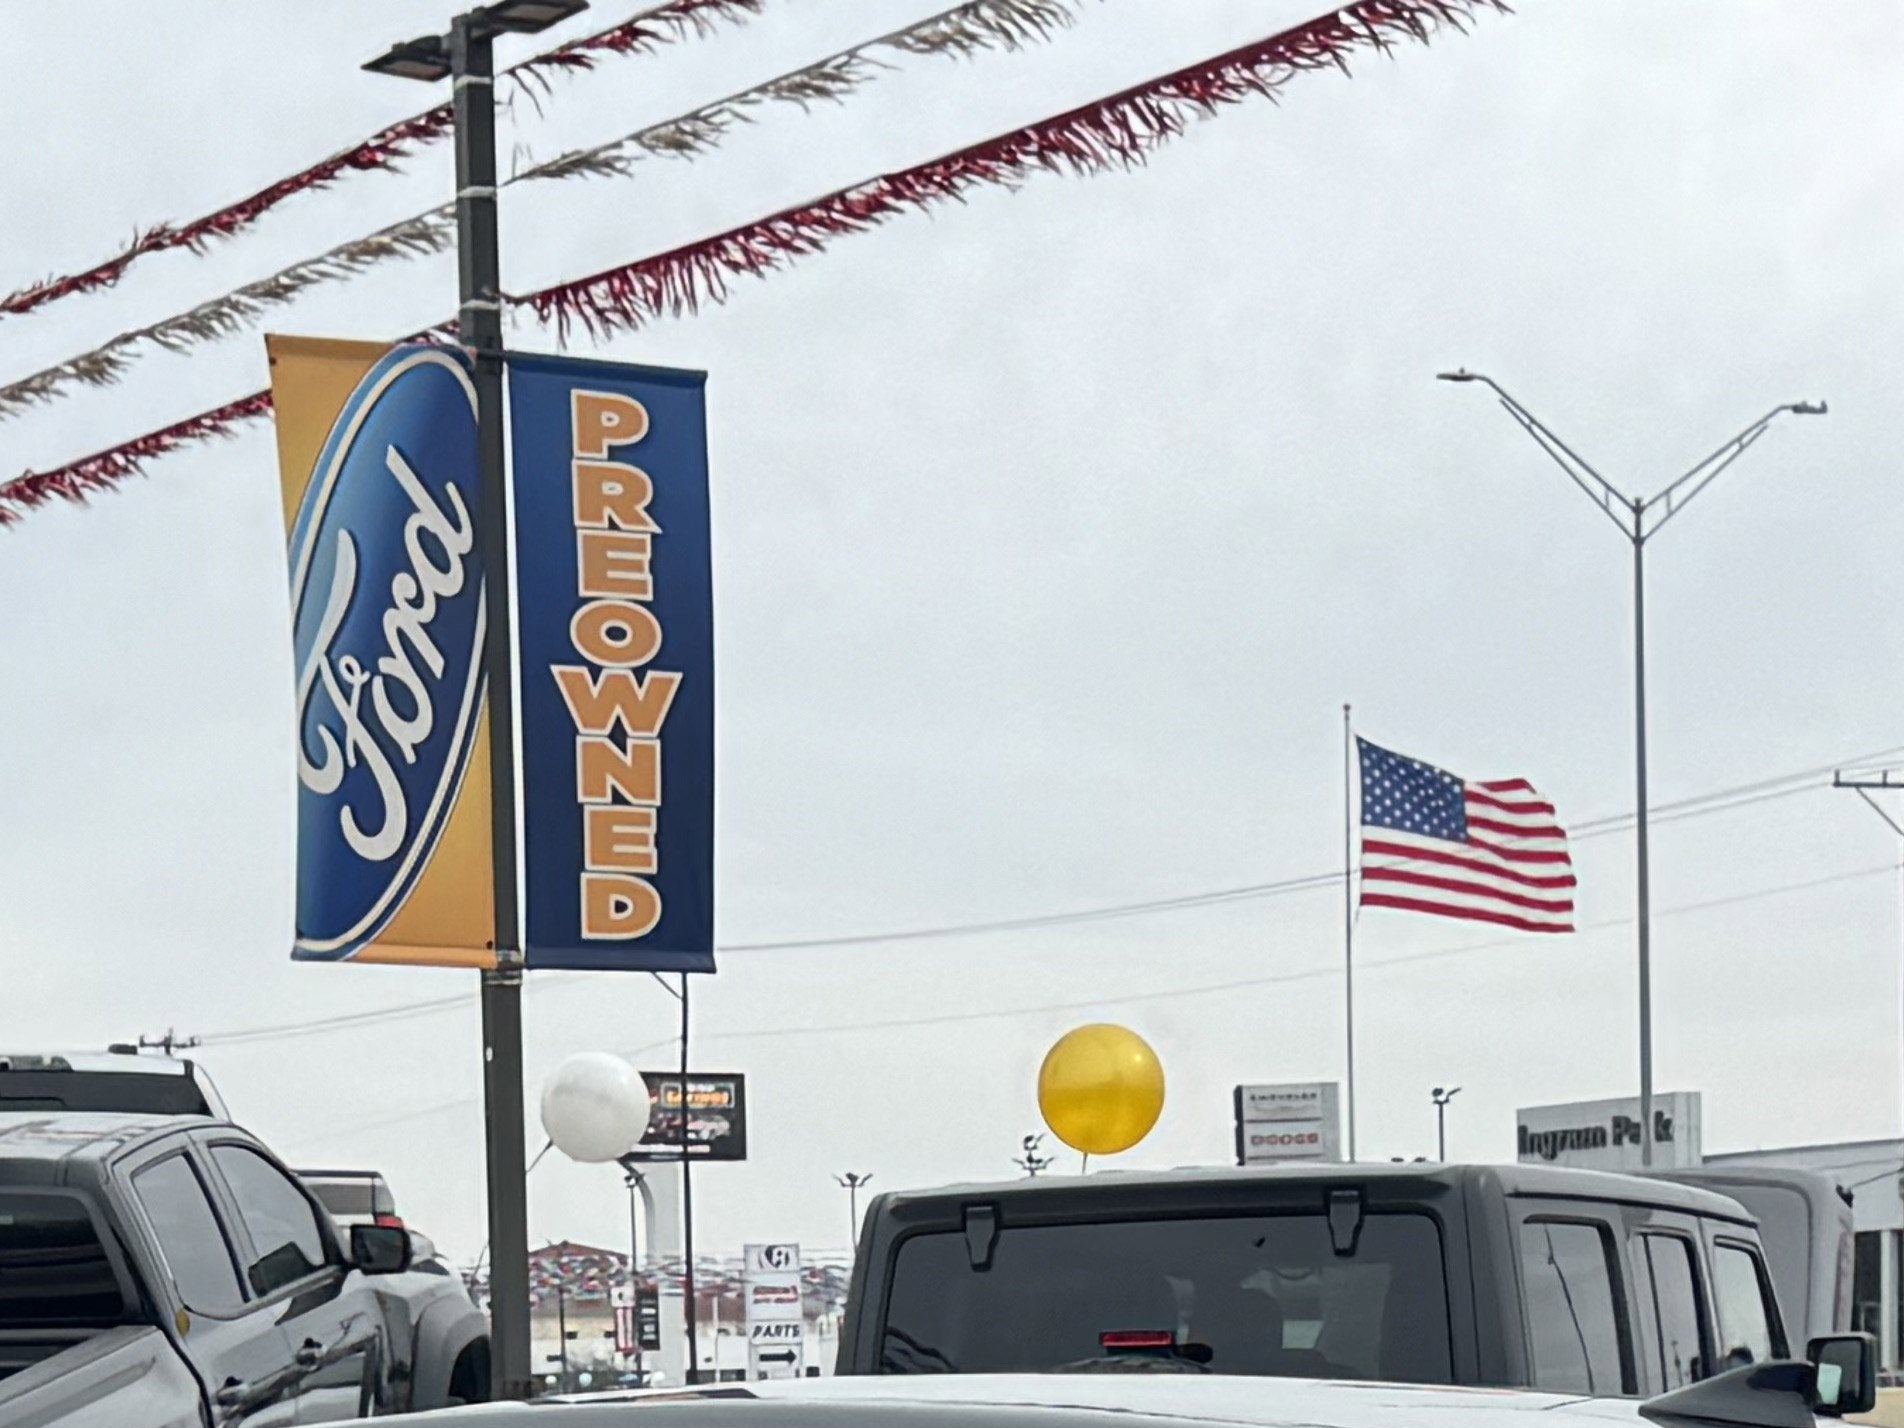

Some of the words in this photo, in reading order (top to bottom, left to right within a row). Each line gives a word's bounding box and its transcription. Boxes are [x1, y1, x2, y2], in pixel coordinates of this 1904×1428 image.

[297, 444, 474, 862] Ford
[550, 388, 683, 940] PREOWNED
[1612, 1110, 1674, 1147] Pak
